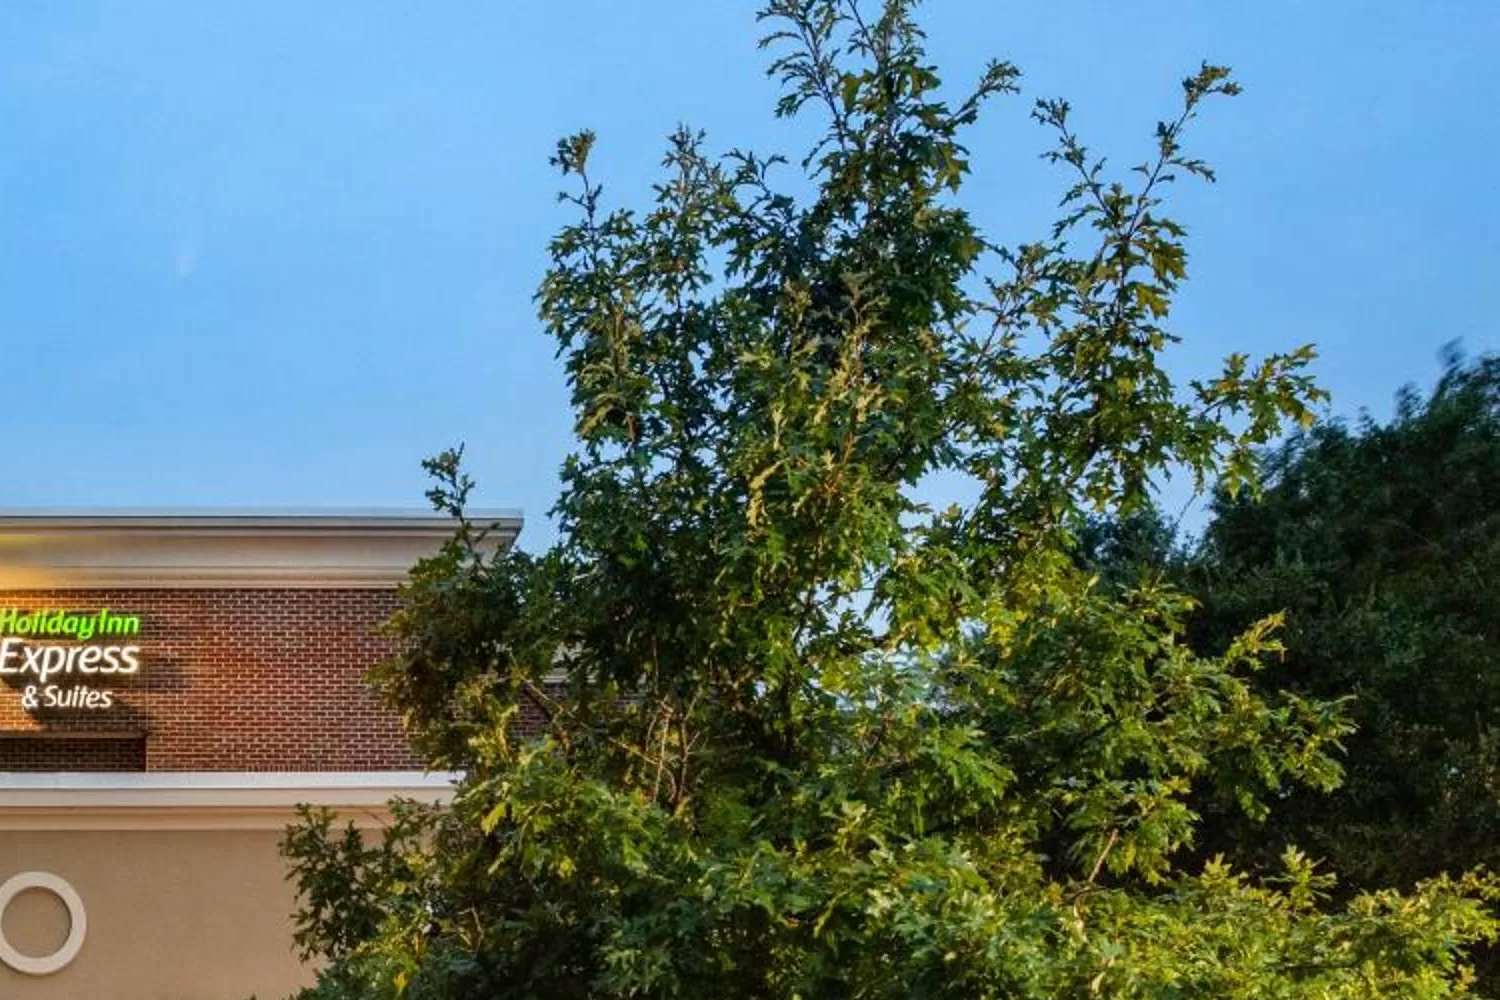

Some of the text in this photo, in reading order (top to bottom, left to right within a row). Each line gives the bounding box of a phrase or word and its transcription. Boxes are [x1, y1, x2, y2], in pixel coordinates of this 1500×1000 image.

[99, 608, 139, 633] Inn
[21, 684, 113, 708] & Suites
